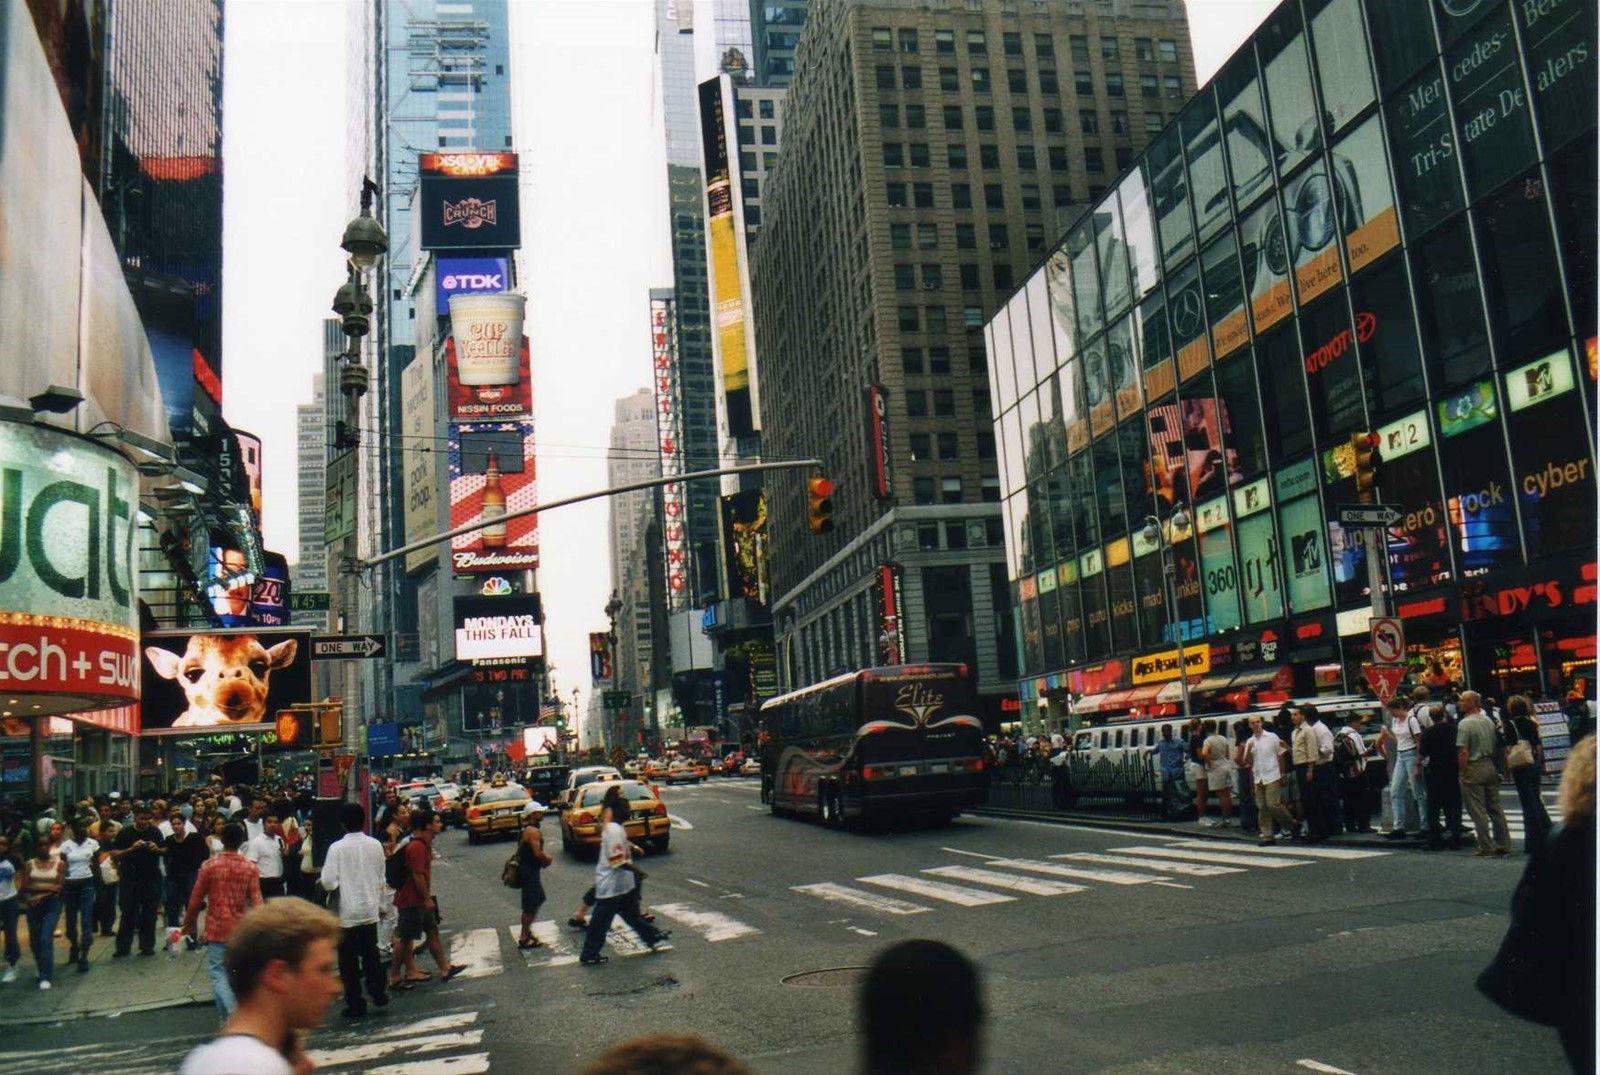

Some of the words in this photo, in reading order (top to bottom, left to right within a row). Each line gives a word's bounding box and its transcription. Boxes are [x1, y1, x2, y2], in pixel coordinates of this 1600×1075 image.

[433, 154, 504, 169] DISCOVER
[446, 204, 495, 221] CRUNCH
[1350, 243, 1370, 260] too.
[456, 274, 502, 289] TDK
[470, 322, 508, 341] CUP
[460, 340, 516, 359] NOODLES
[1524, 361, 1554, 398] MTV
[457, 404, 489, 414] NISSIN
[491, 403, 524, 413] FOODS
[410, 461, 429, 494] pork
[1523, 457, 1588, 499] cyber
[1346, 511, 1365, 520] ONE
[1376, 511, 1396, 520] WAY
[1402, 505, 1436, 533] ero
[0, 466, 136, 608] at
[453, 552, 538, 568] Budweiser
[1290, 530, 1322, 575] MTV
[1209, 565, 1235, 596] 360
[291, 596, 300, 608] W
[303, 596, 315, 608] 45
[1142, 587, 1163, 608] mad
[1112, 599, 1135, 616] kicks
[463, 614, 534, 629] MONDAYS
[463, 629, 496, 641] THIS
[500, 628, 534, 640] FALL
[321, 643, 343, 653] ONE
[352, 642, 375, 652] WAY
[472, 656, 527, 667] Panasonic
[894, 682, 945, 709] Elite
